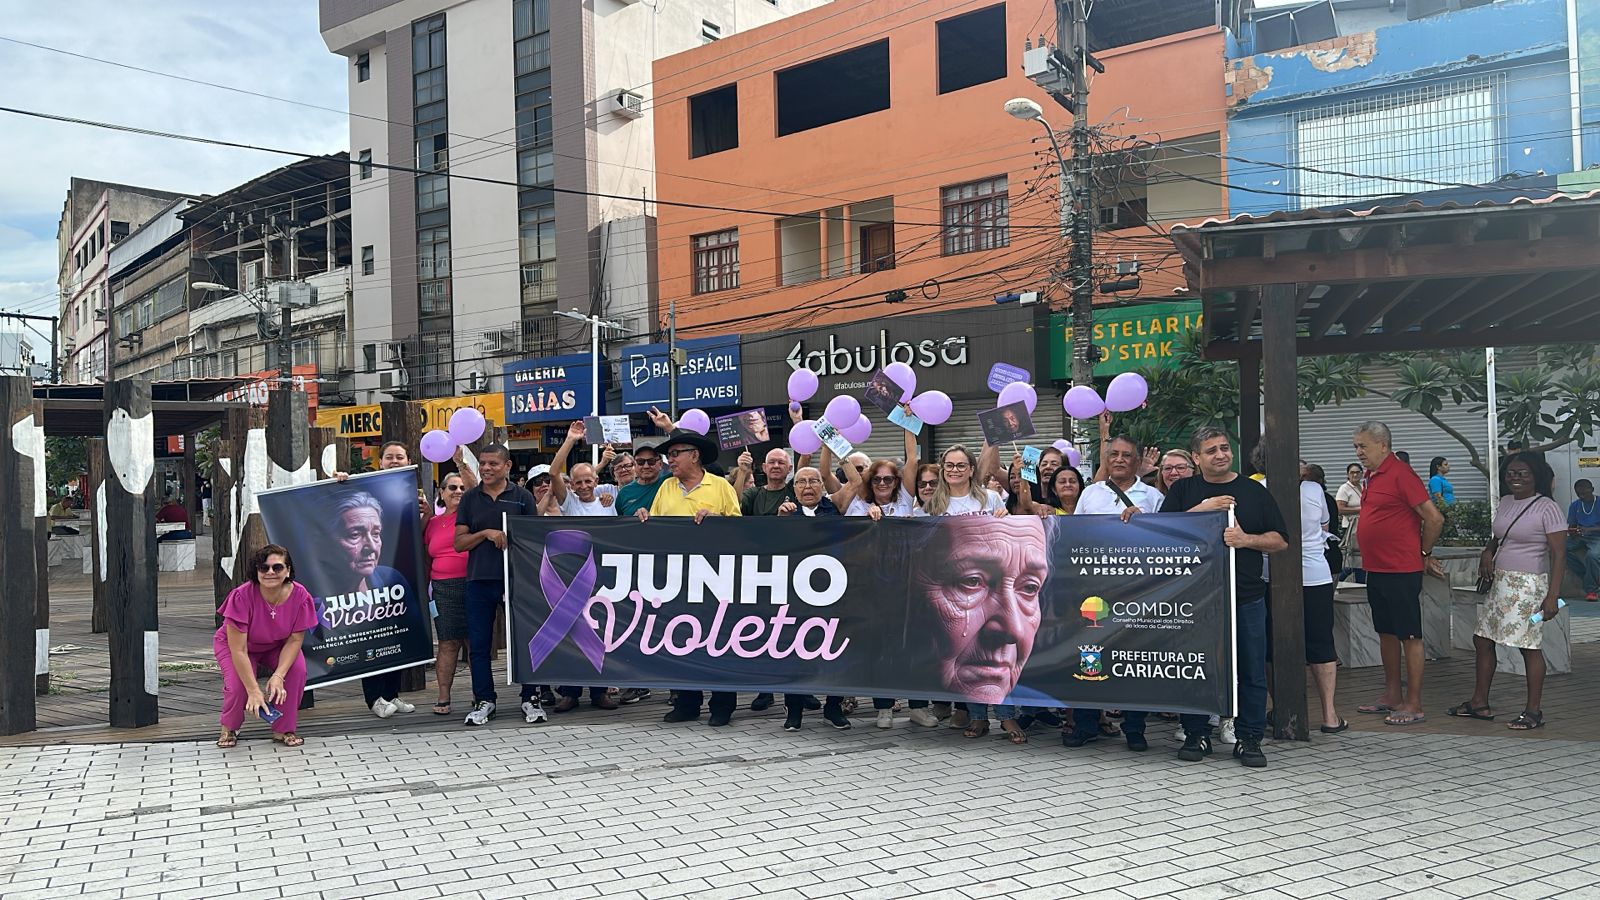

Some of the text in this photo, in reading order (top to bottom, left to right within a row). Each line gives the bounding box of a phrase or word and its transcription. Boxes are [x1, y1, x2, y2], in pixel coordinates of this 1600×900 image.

[1065, 312, 1203, 342] PSTELARIA
[652, 353, 737, 377] BAESFÁCIL
[515, 366, 566, 383] GALERIA
[510, 386, 576, 414] ISAÍAS
[695, 384, 738, 399] PAVESI
[1071, 546, 1090, 554] MÊS
[1193, 545, 1201, 553] À
[1070, 554, 1202, 565] VIOLÊNCIA CONTRA
[595, 553, 848, 607] JUNHO
[1079, 567, 1193, 576] A PESSOA IDOSA
[325, 584, 405, 612] JUNHO
[322, 601, 408, 628] Violeta
[1112, 601, 1193, 617] COMDIC
[582, 590, 850, 661] Violeta
[1111, 650, 1205, 663] PREFEITURA DE
[1111, 662, 1206, 680] CARIACICA
